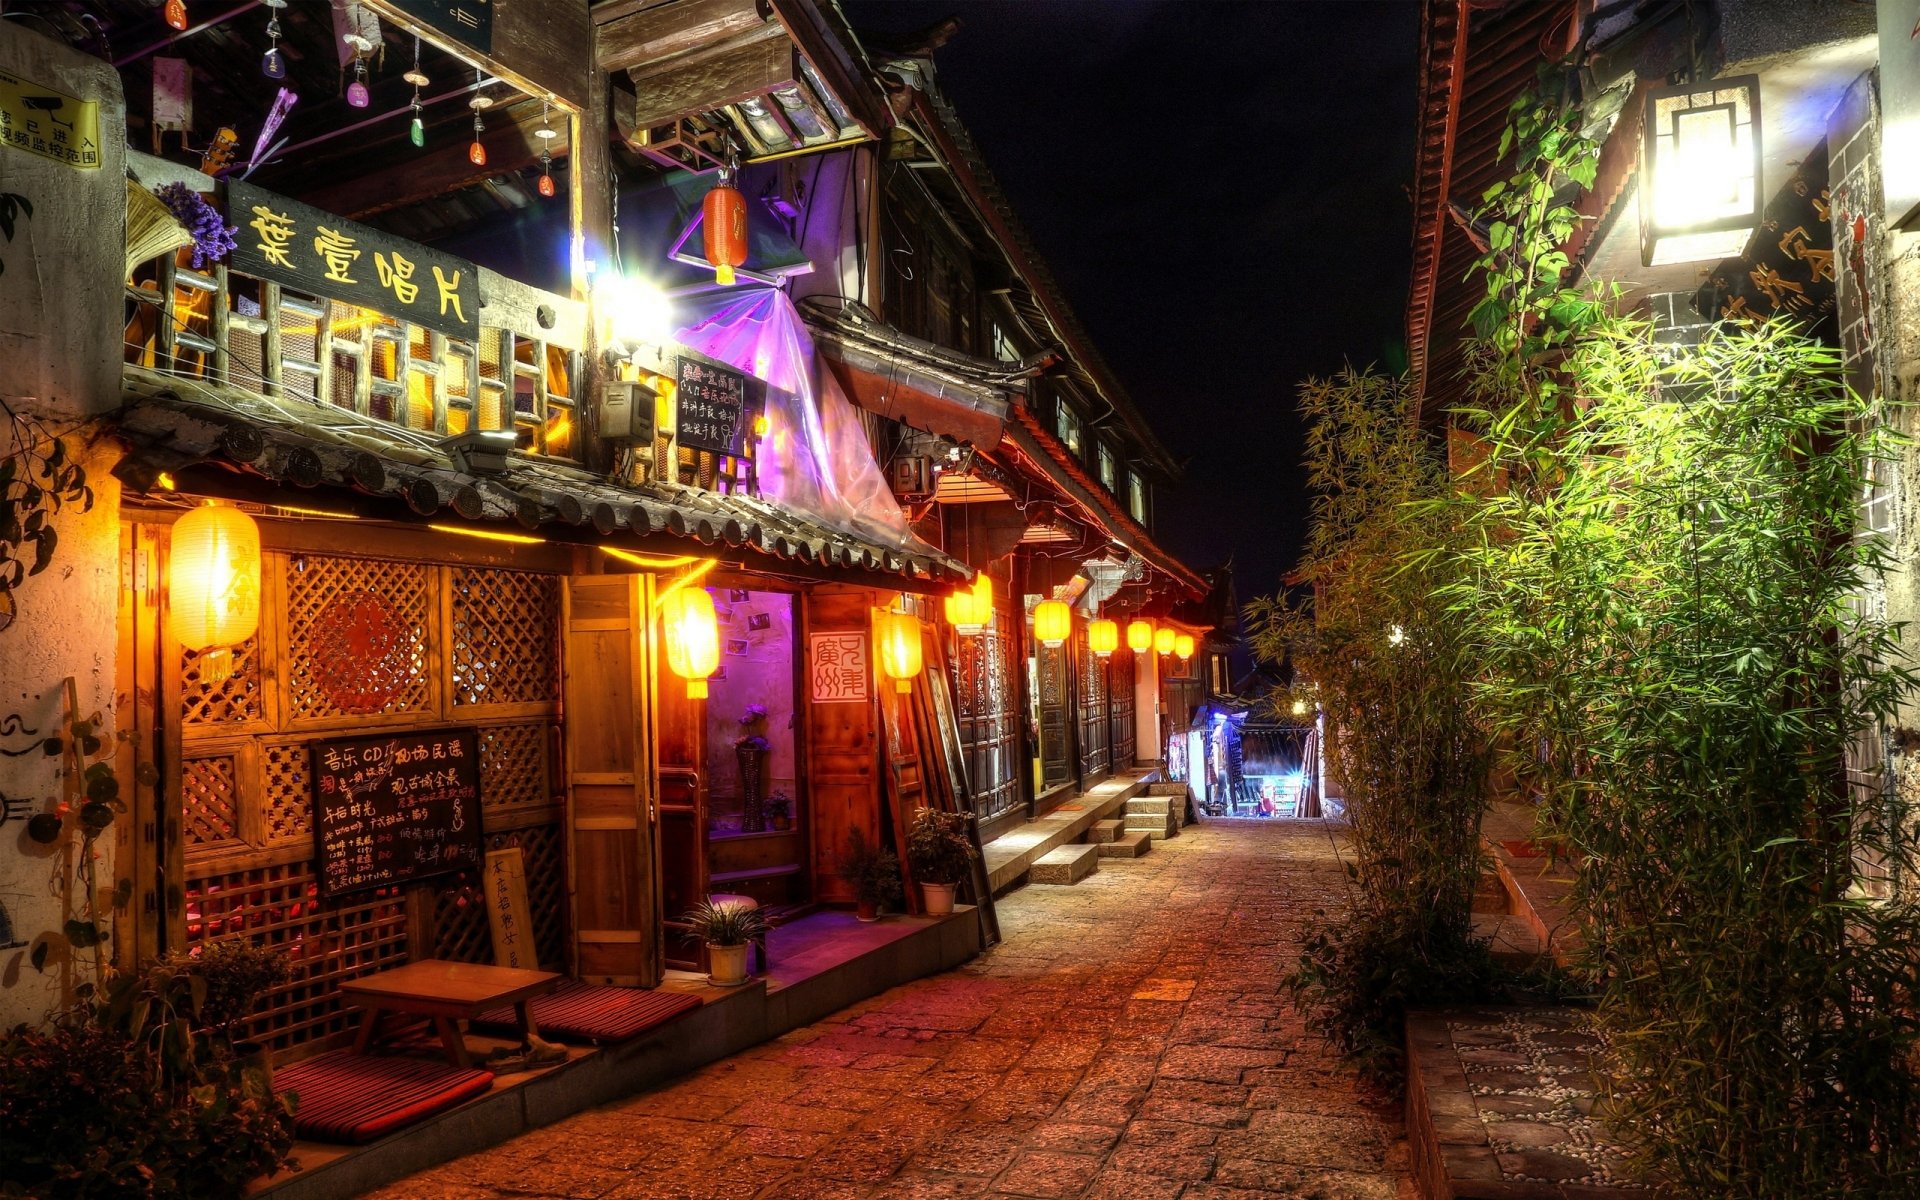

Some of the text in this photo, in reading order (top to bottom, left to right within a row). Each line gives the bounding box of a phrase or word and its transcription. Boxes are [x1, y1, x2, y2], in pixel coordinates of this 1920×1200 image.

[324, 747, 383, 771] 音乐 CD
[394, 739, 464, 765] 现场民谣
[391, 767, 461, 795] 观古城全景
[323, 800, 376, 824] 午后时光
